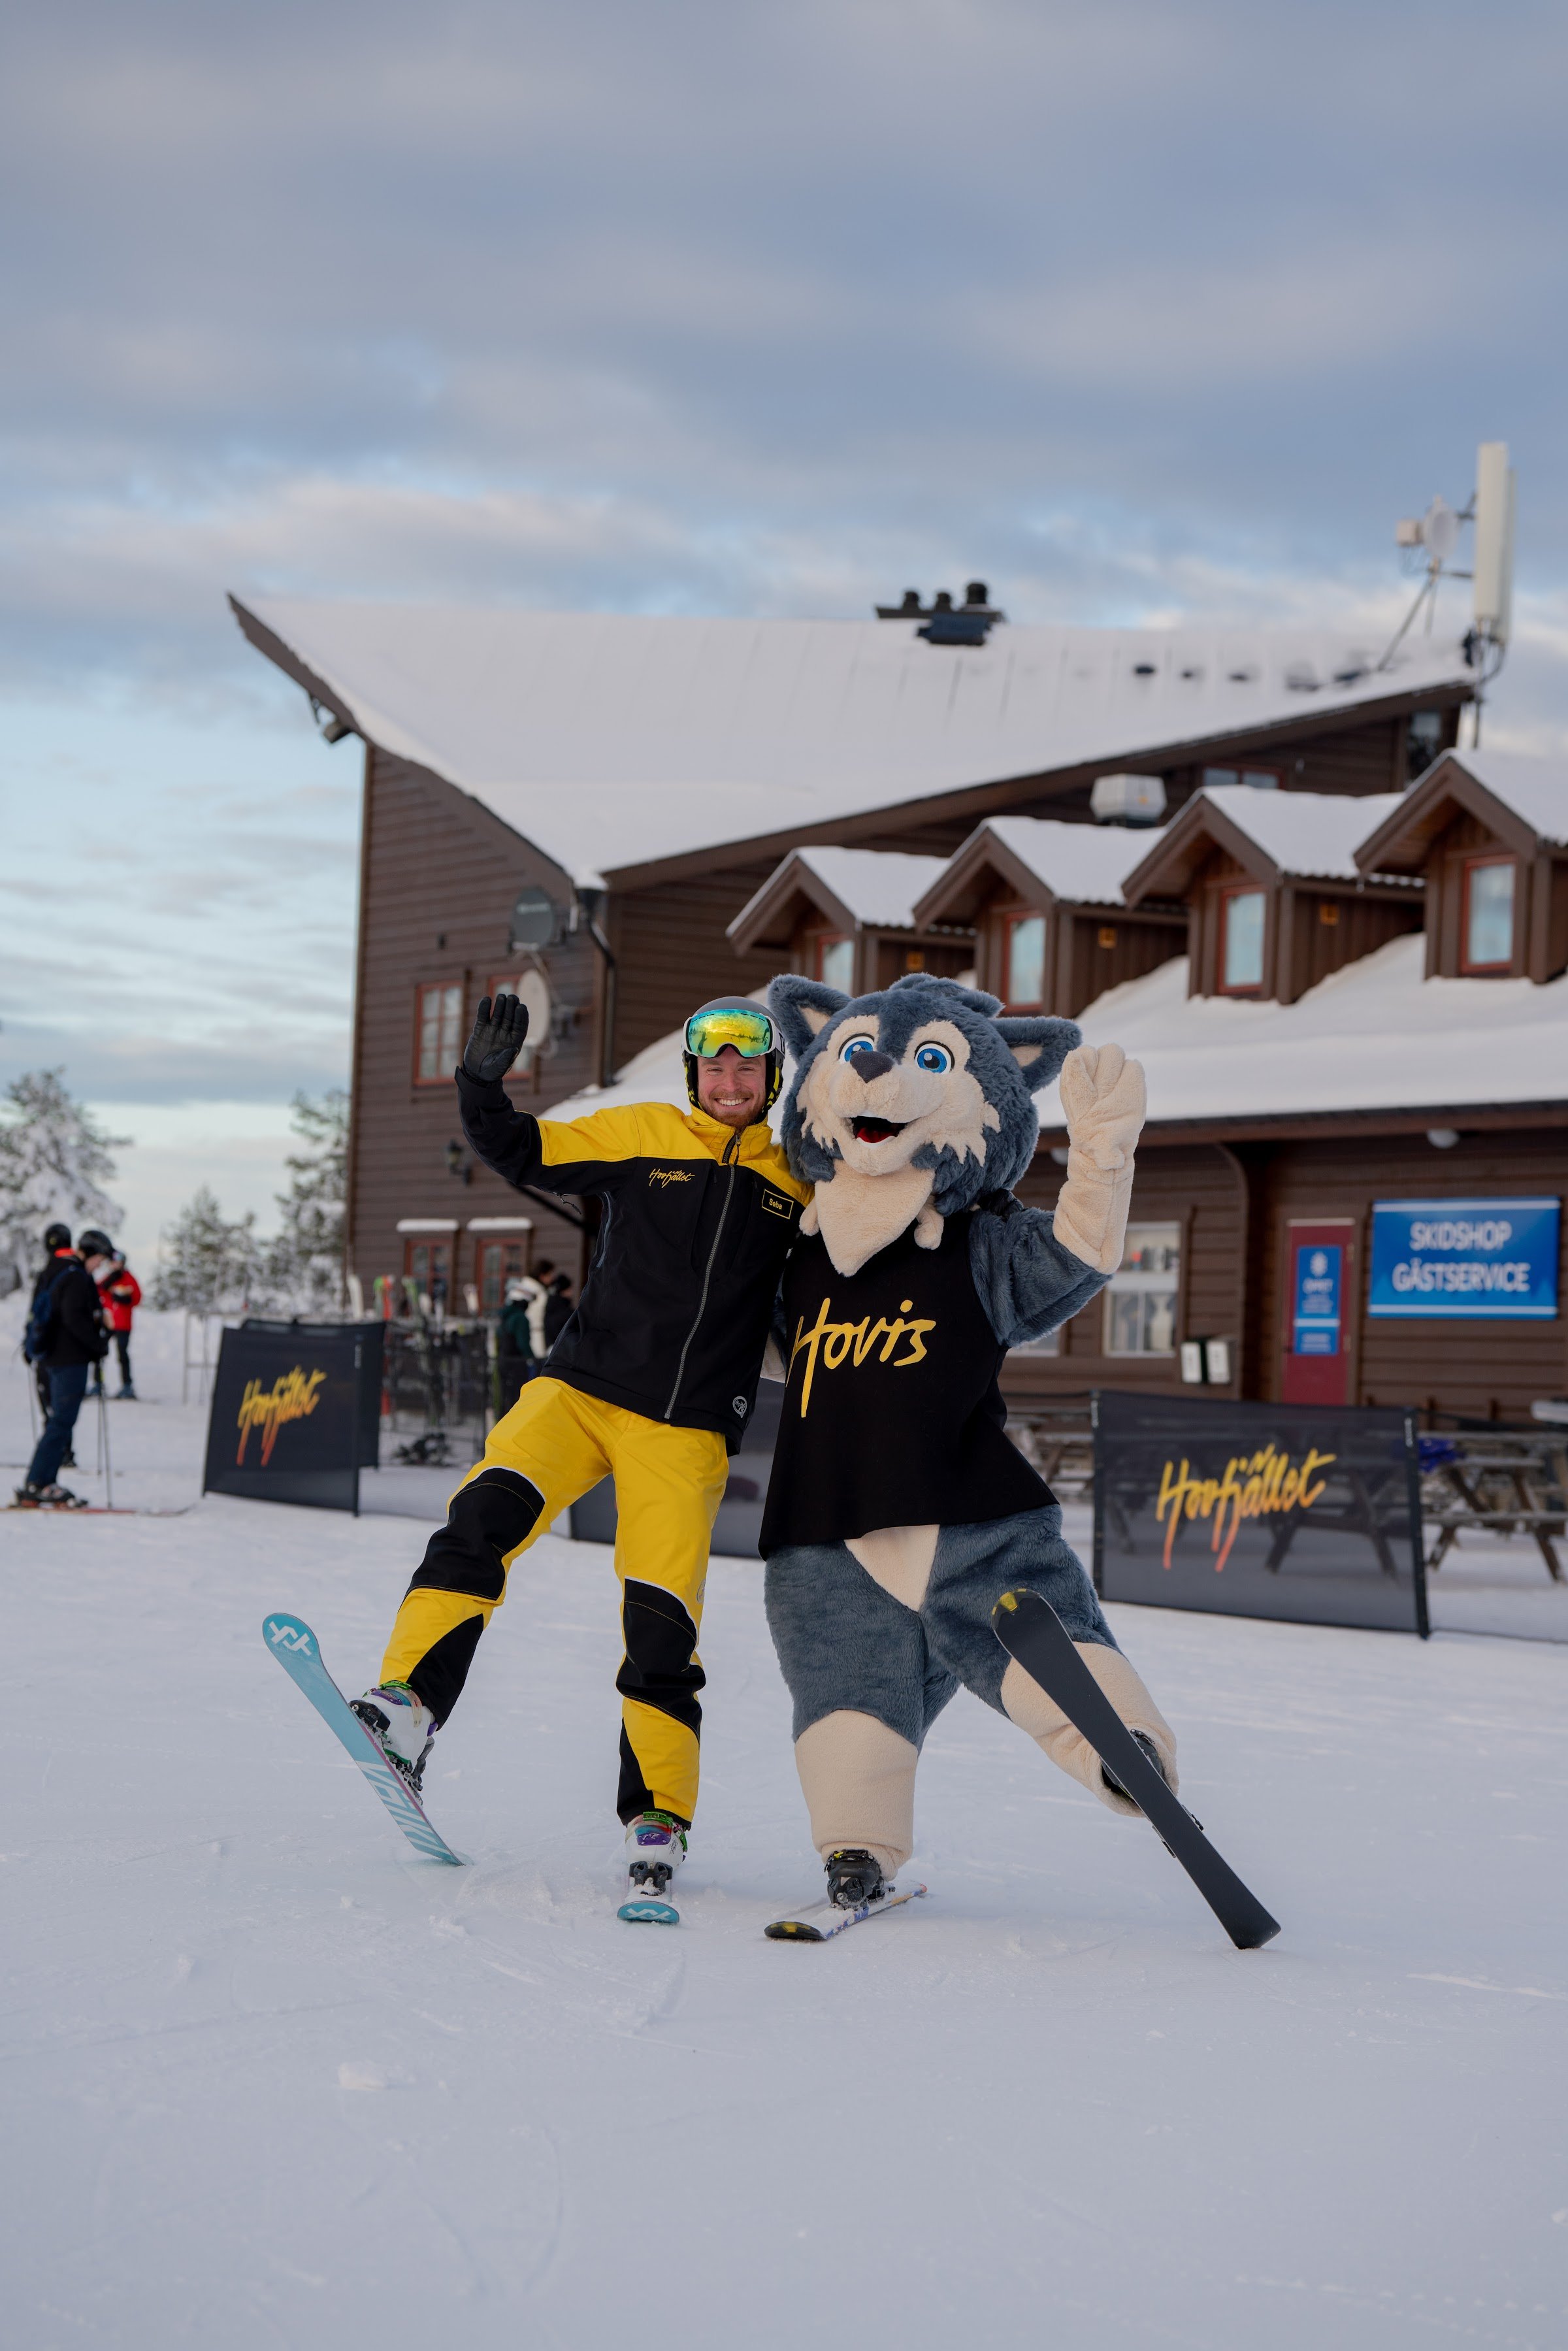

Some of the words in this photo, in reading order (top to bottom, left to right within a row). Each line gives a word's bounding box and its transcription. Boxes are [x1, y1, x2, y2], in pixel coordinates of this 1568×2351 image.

[649, 1168, 695, 1188] Hovfjället
[769, 1198, 782, 1209] Seba
[1410, 1220, 1512, 1251] SKIDSHOP
[1392, 1257, 1531, 1292] GÄSTSERVICE
[785, 1298, 936, 1418] Hovis
[1155, 1442, 1337, 1572] Hovfjället
